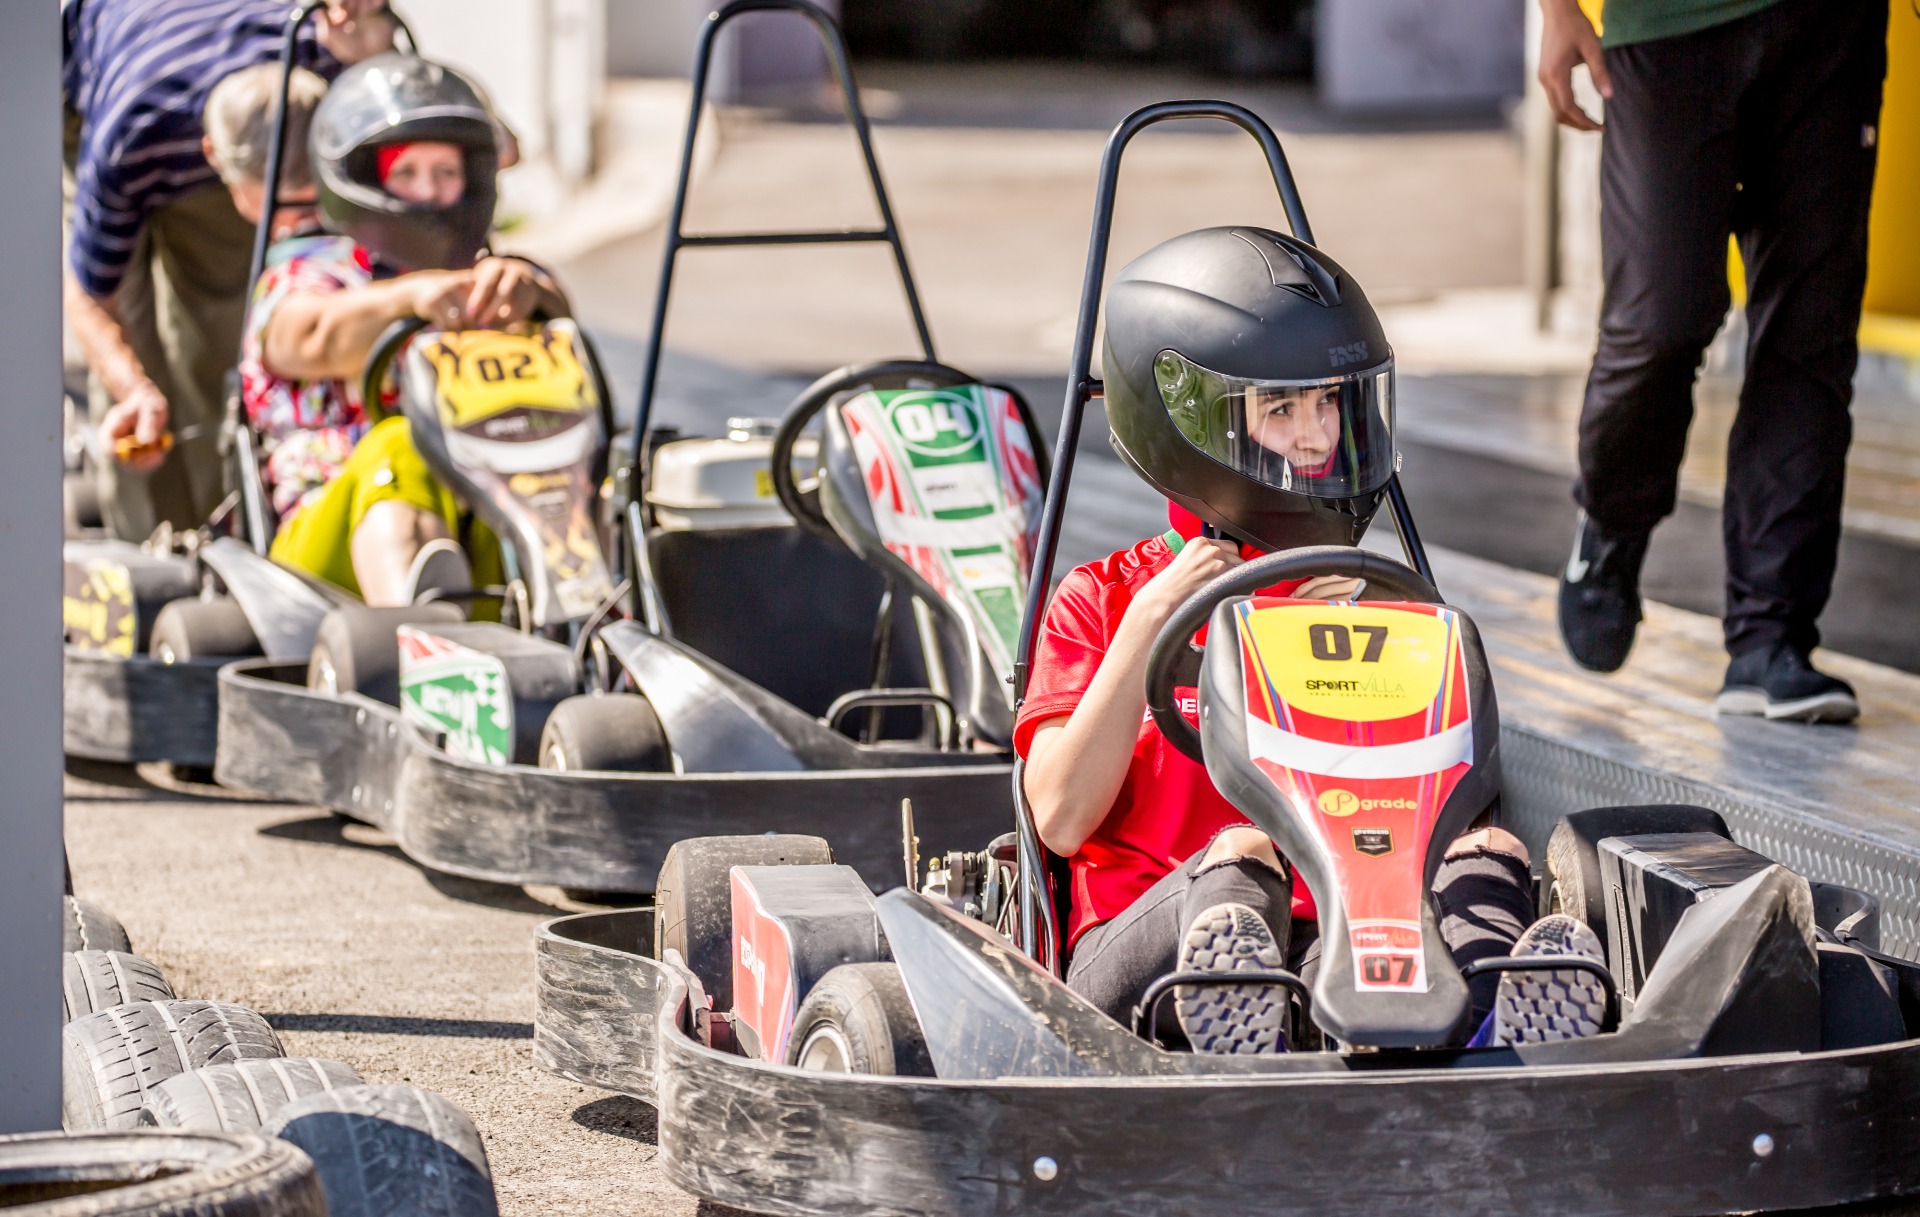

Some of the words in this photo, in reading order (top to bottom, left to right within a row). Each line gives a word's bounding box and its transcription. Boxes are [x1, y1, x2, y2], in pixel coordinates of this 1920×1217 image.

[478, 353, 538, 382] 02
[894, 402, 975, 442] 04
[1309, 623, 1388, 662] 07
[1360, 798, 1418, 811] grade
[1363, 955, 1415, 984] 07
